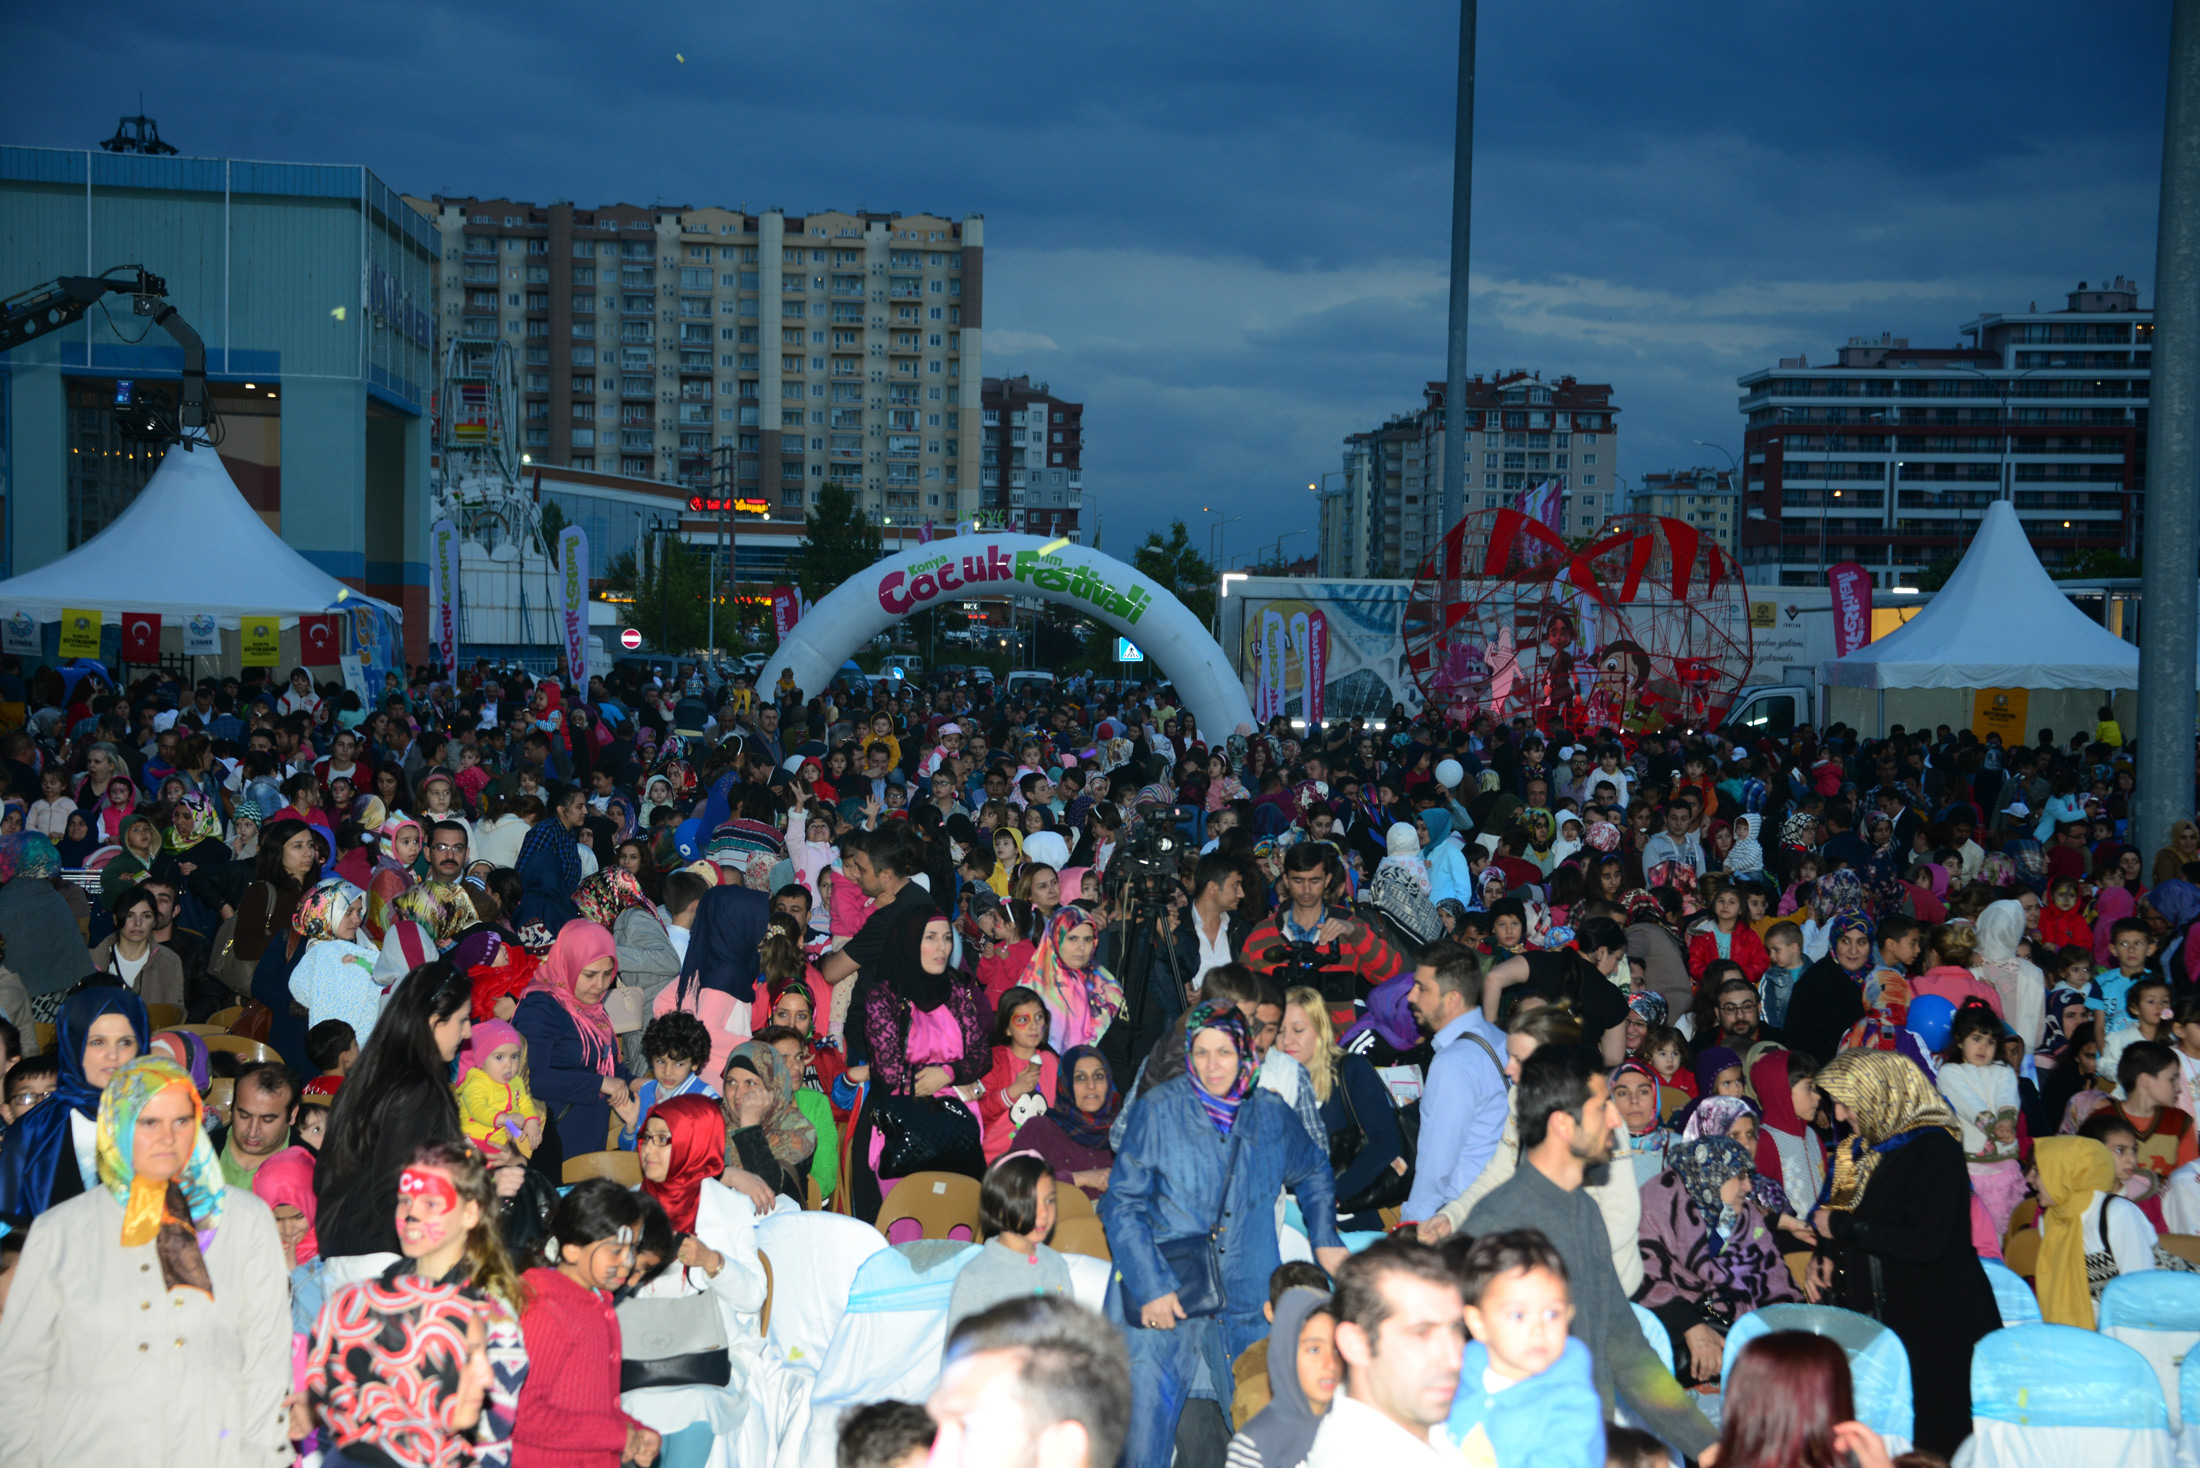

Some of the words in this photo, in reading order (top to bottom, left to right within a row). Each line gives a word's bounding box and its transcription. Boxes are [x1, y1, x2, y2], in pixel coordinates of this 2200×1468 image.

[879, 545, 1014, 616] Çocuk
[1014, 550, 1153, 625] Festivali
[907, 553, 948, 577] Konya
